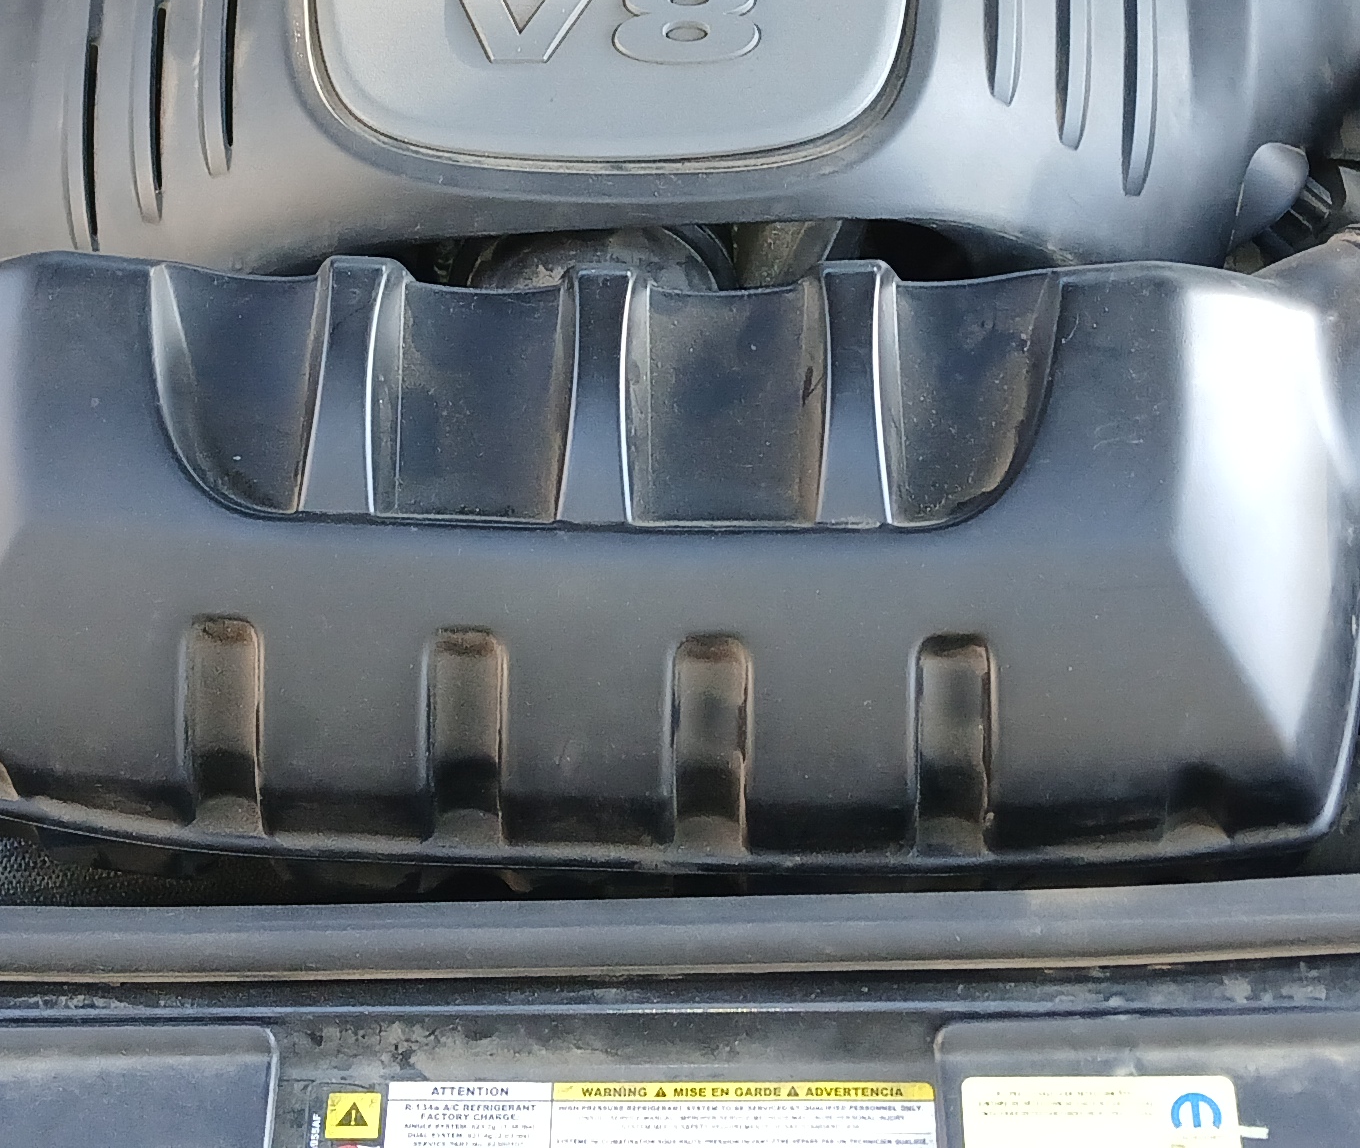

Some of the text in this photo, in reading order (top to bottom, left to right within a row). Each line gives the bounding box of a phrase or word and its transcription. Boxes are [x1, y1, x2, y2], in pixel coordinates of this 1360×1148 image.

[431, 1086, 510, 1097] ATTENTION
[581, 1086, 904, 1098] WARNING MISE EN GARDE ADVERTENCIA
[420, 1113, 470, 1121] FACTORY
